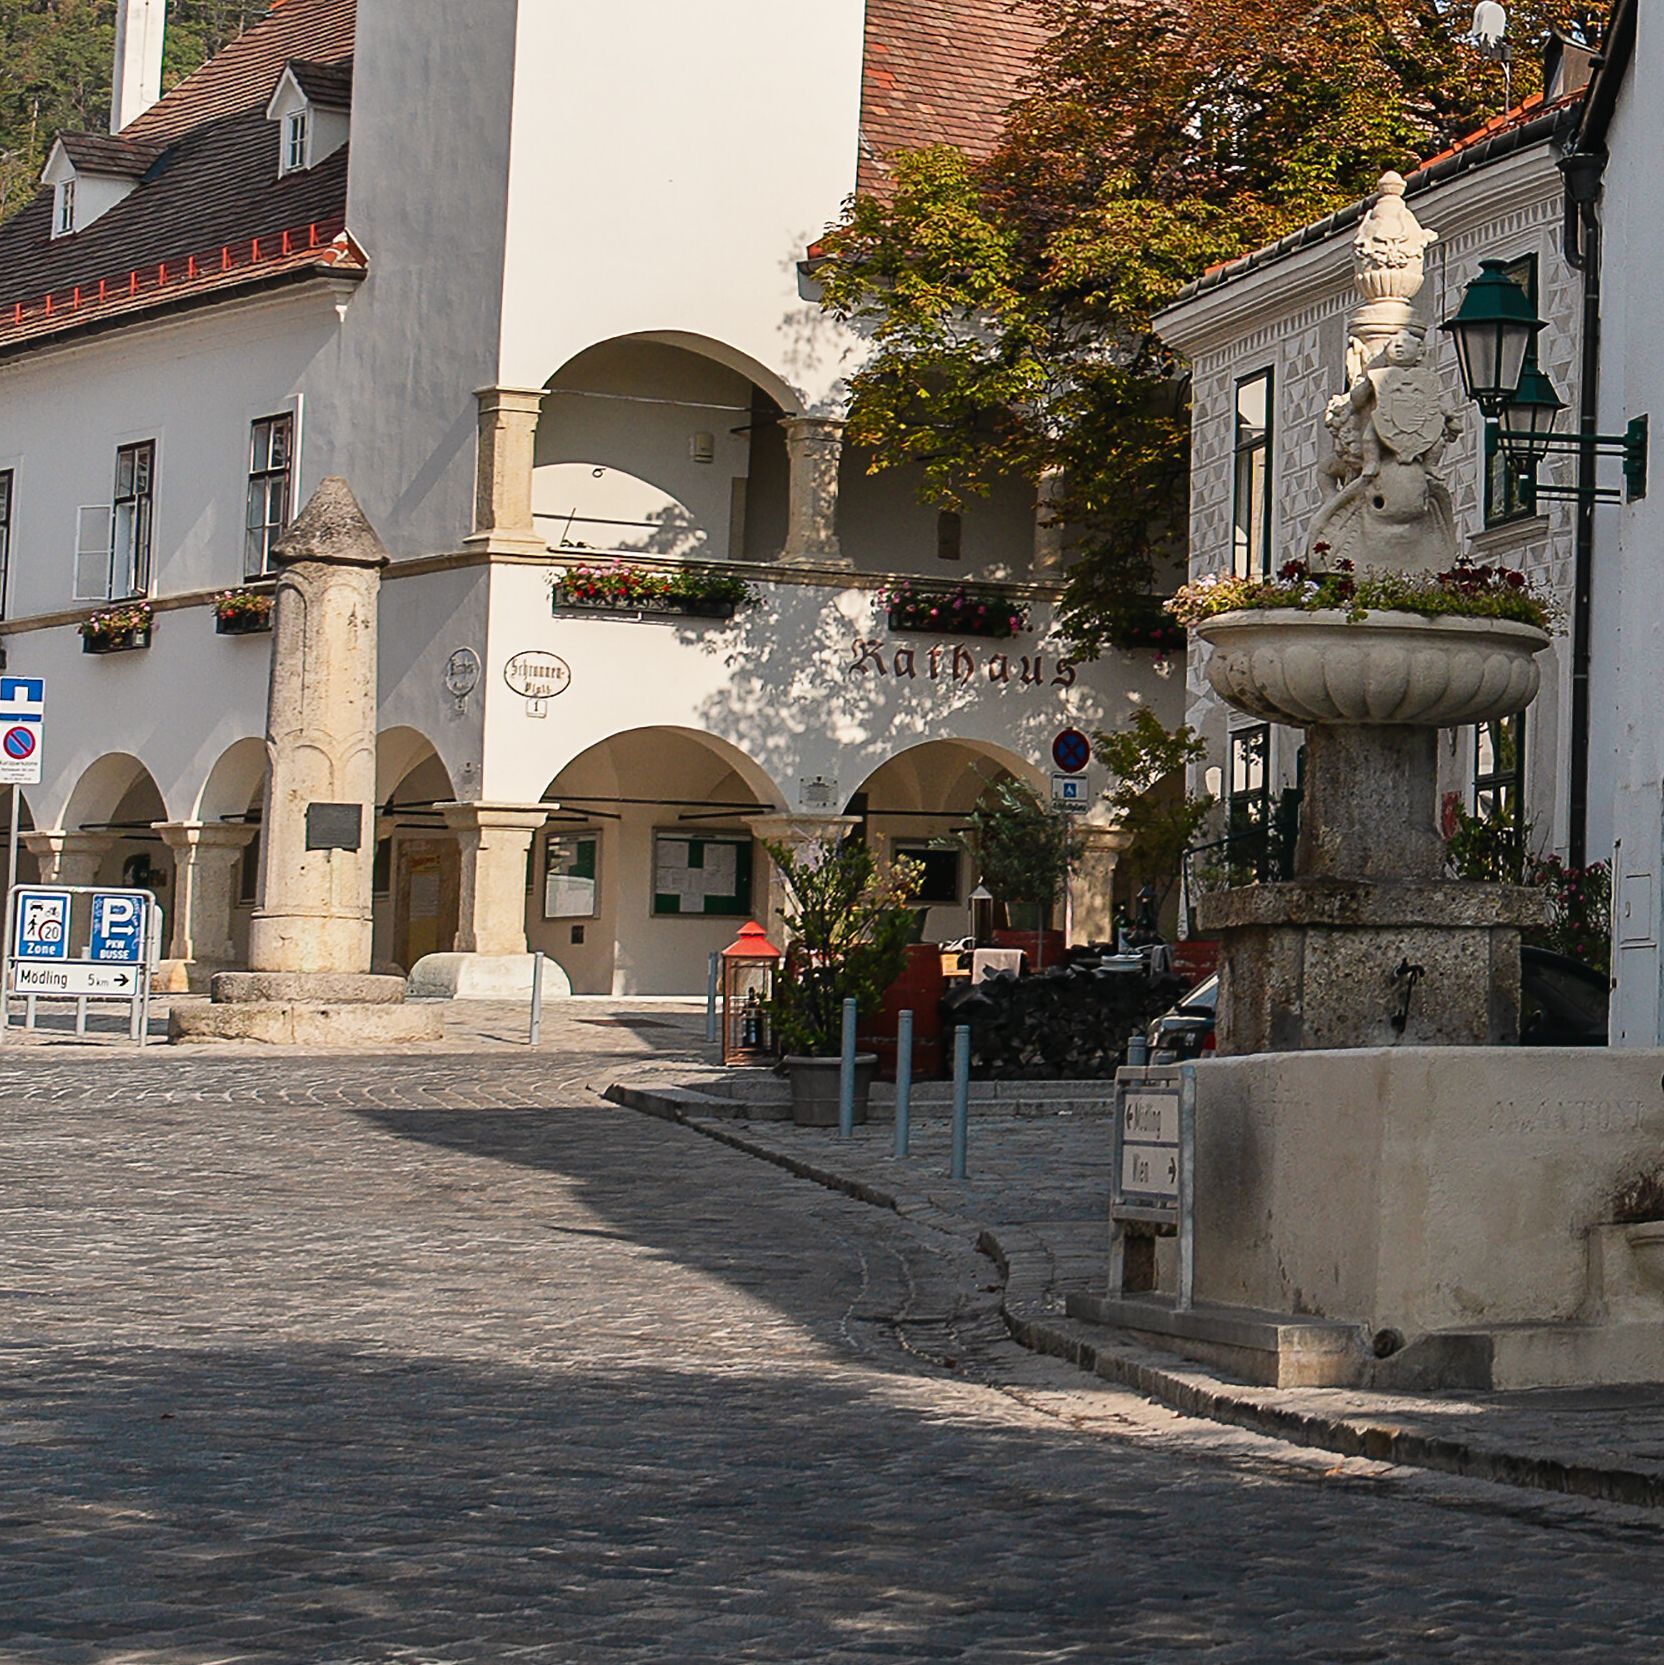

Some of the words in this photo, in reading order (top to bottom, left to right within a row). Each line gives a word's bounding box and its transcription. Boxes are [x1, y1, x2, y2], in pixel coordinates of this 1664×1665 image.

[849, 638, 1084, 688] Rathaus
[100, 897, 134, 939] P
[44, 926, 60, 940] 20
[27, 941, 56, 956] Zone
[104, 938, 126, 949] PKW
[99, 948, 130, 961] BUSSE
[20, 967, 68, 990] Mödling
[87, 973, 96, 987] 5
